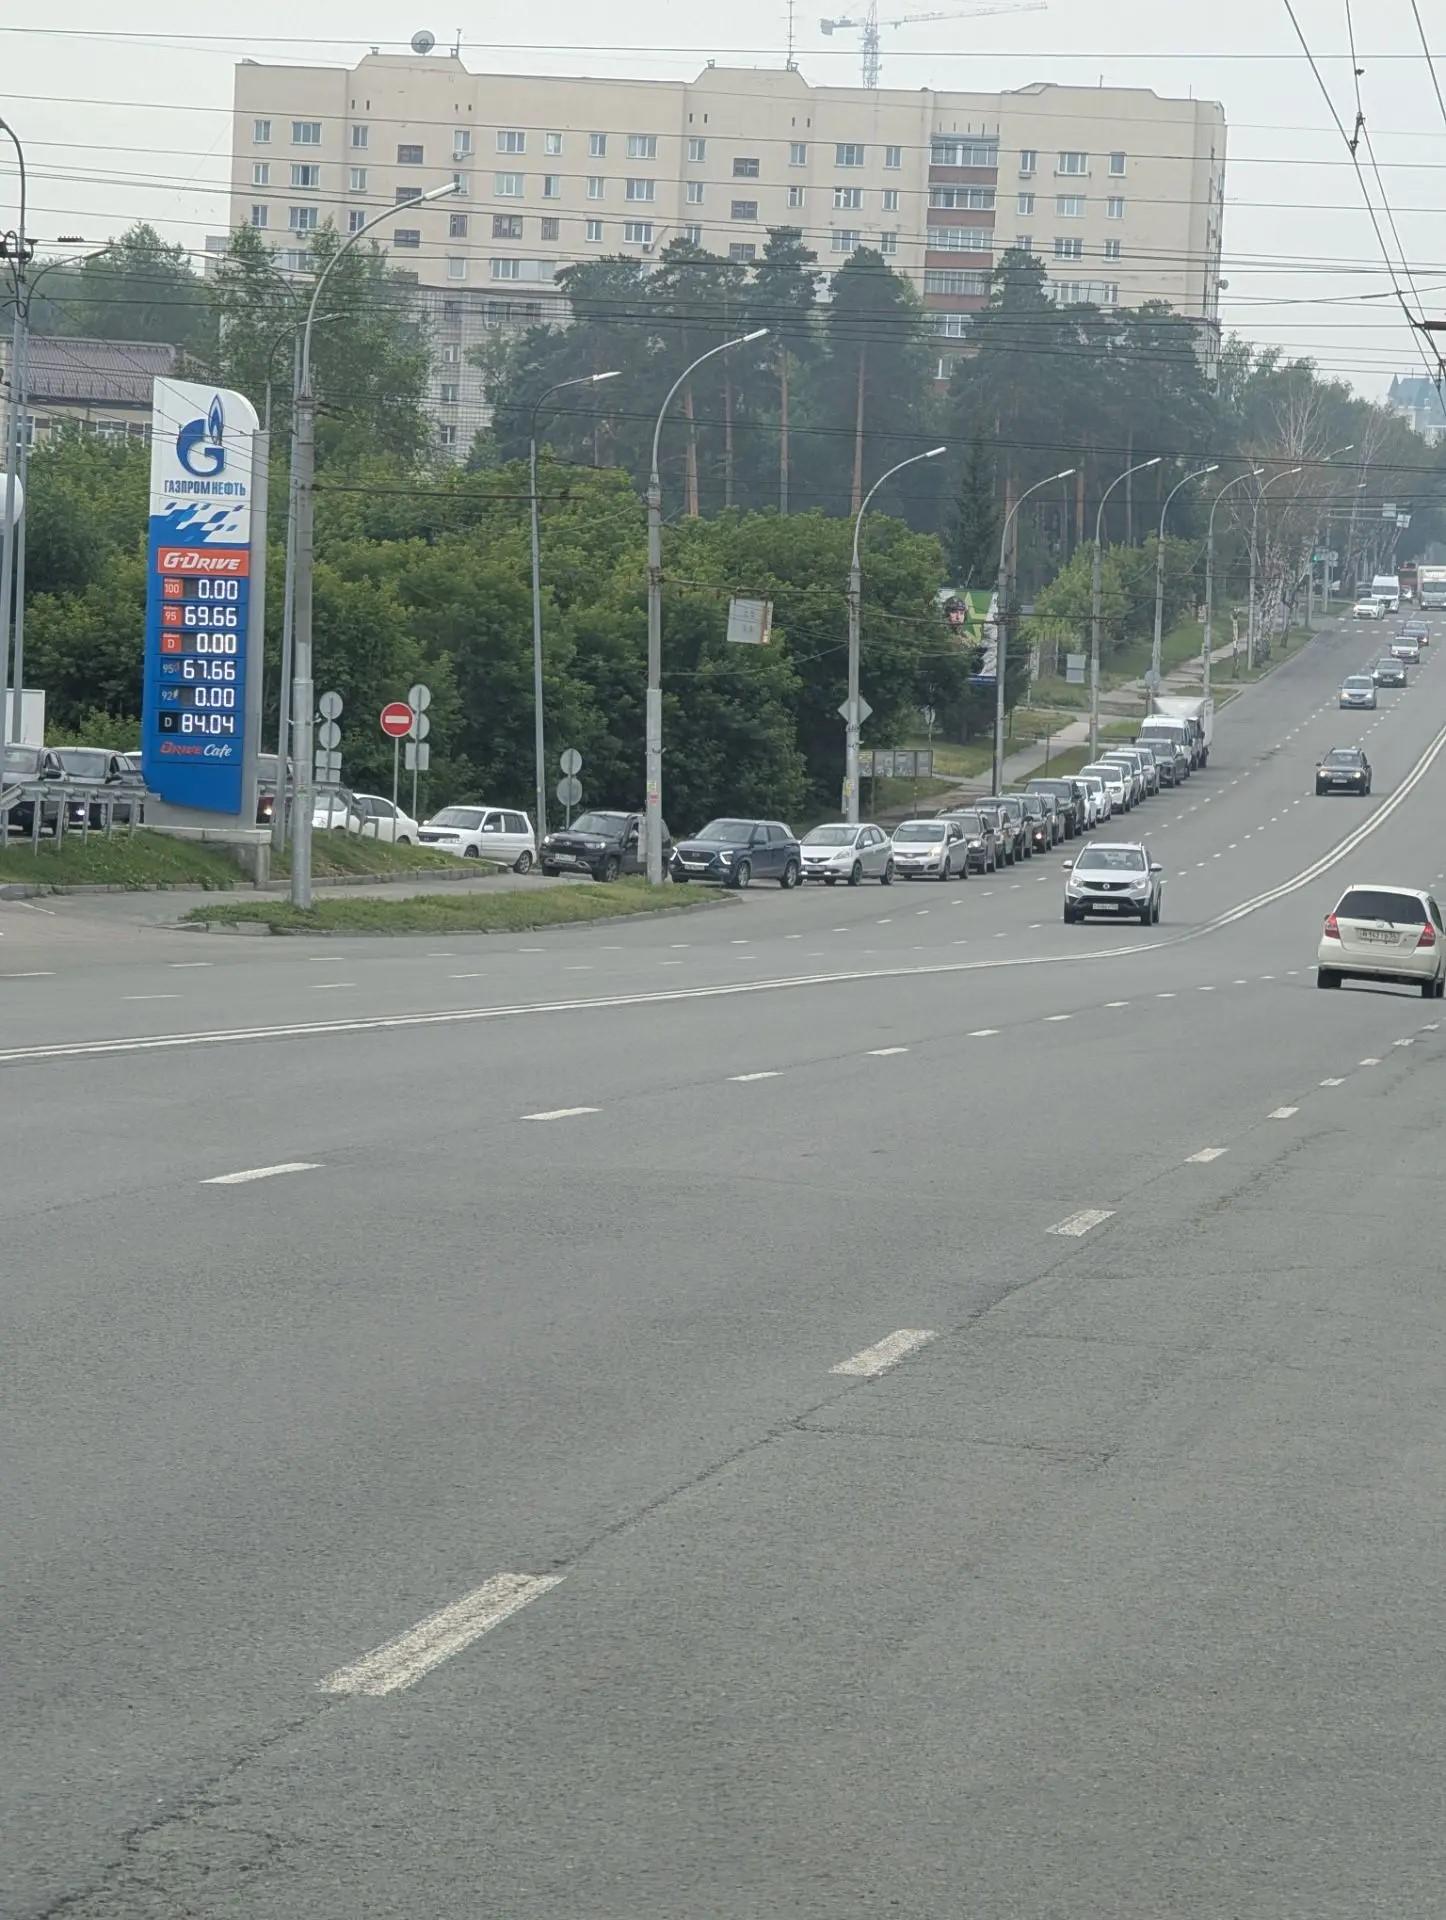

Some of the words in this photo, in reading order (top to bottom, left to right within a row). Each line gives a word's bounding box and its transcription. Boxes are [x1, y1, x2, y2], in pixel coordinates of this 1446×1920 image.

[164, 479, 246, 496] ГАЗПРОМНЕФТЬ
[164, 583, 180, 594] 100
[198, 579, 238, 600] 0.00
[165, 611, 177, 621] 95
[184, 606, 237, 627] 69.66
[196, 633, 237, 654] 0.00
[183, 659, 236, 680] 67.66
[195, 687, 235, 707] 0.00
[164, 717, 172, 727] D
[182, 713, 234, 734] 84.04
[203, 743, 233, 758] Cafe
